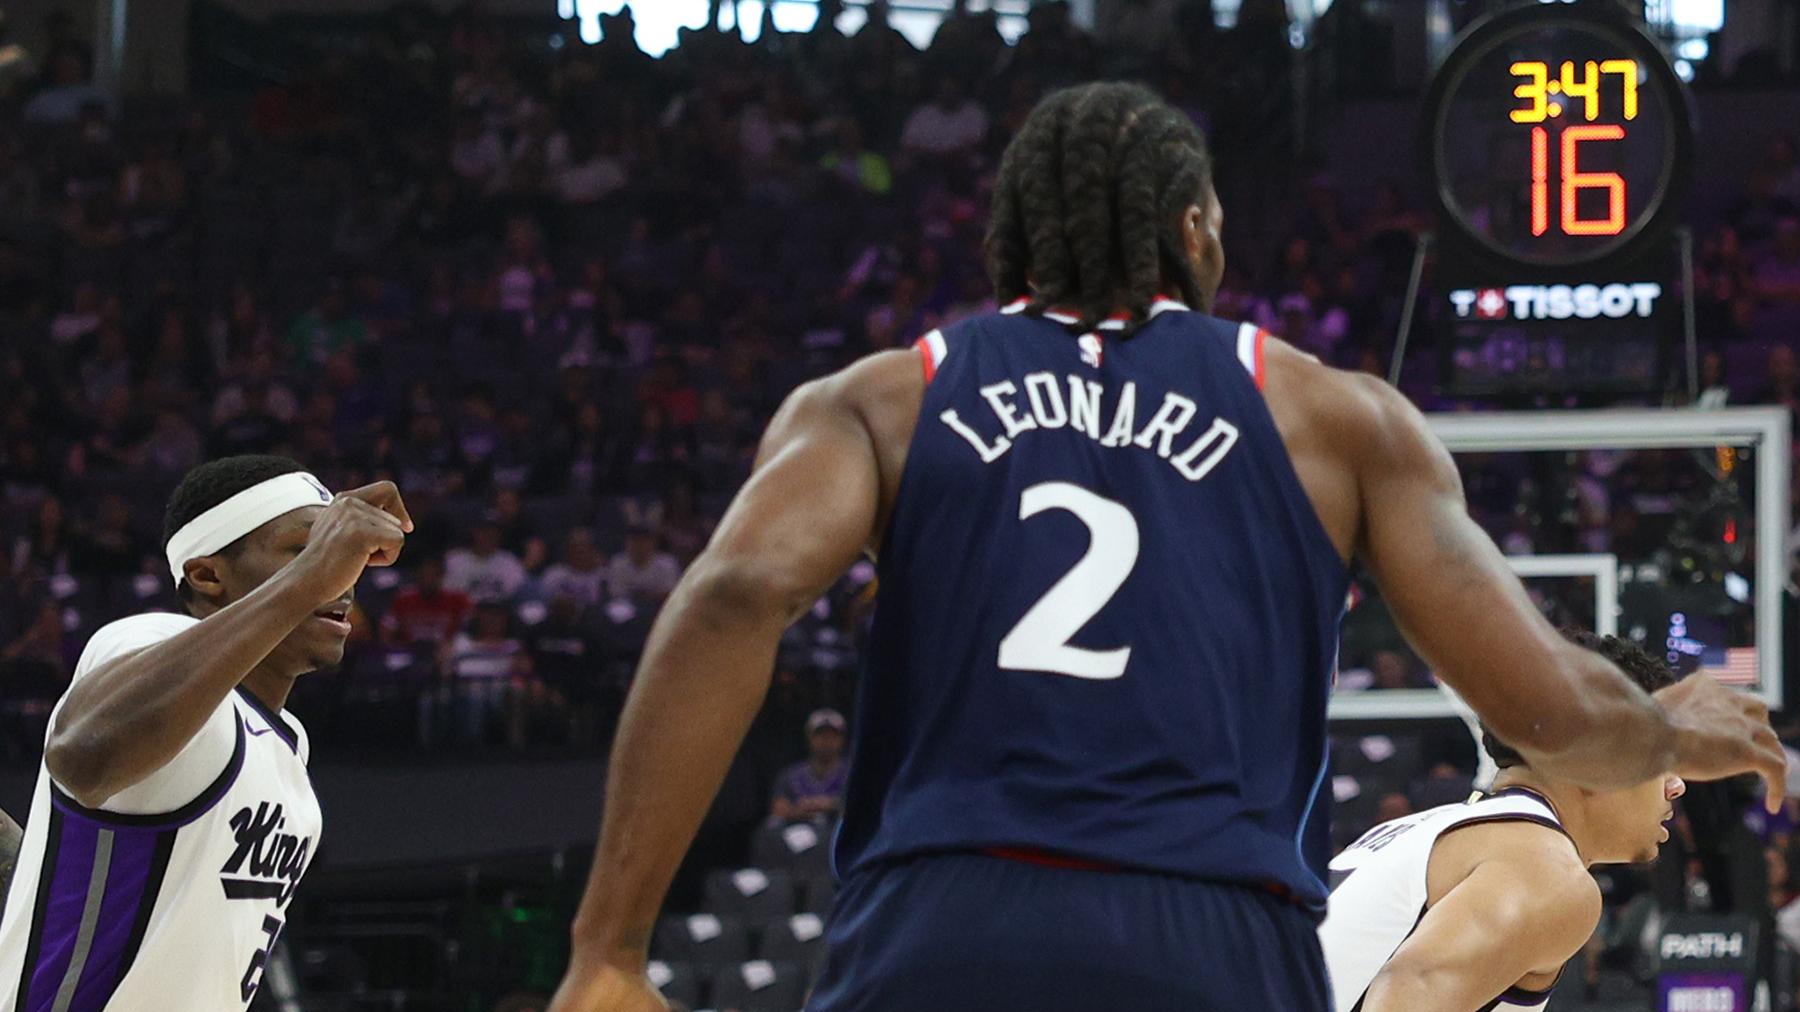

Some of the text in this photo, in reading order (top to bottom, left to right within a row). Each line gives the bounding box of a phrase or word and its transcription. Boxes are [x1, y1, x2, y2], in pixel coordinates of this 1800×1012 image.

[1509, 60, 1638, 123] 3:47
[1531, 125, 1626, 237] 16
[1505, 282, 1662, 320] TISSOT
[939, 371, 1240, 482] LEONARD
[997, 481, 1140, 680] 2
[1660, 932, 1743, 959] PATH
